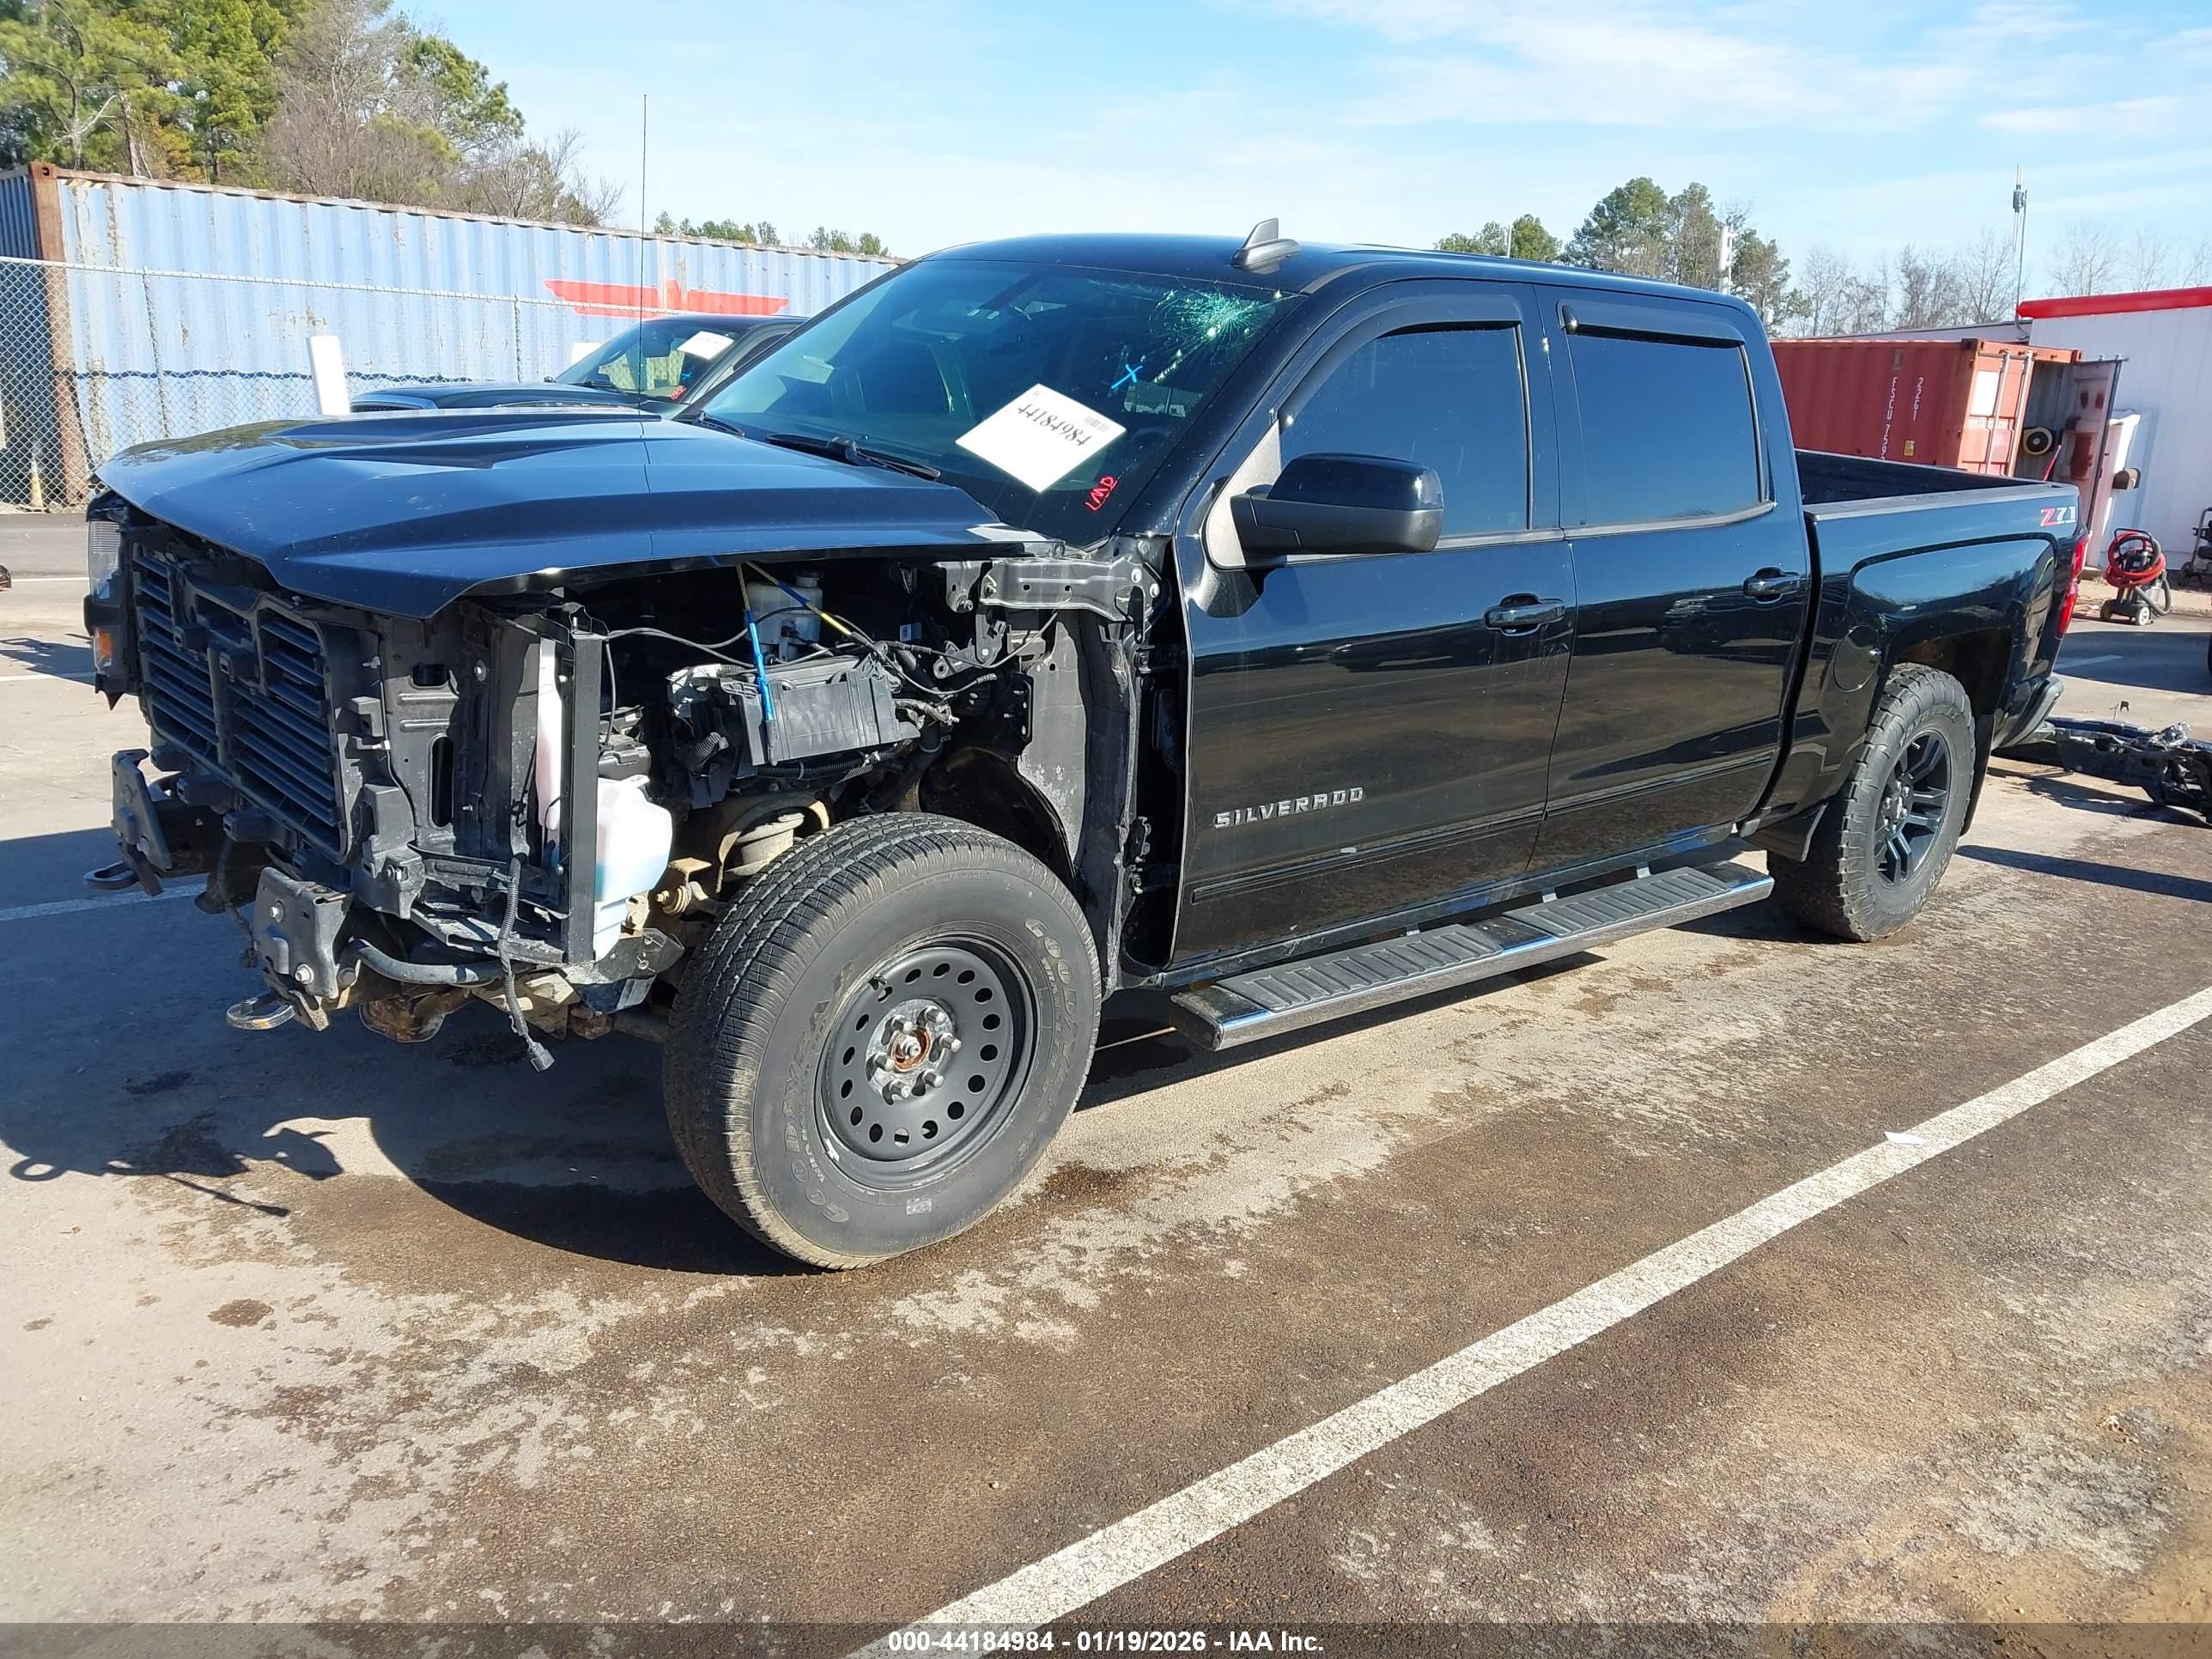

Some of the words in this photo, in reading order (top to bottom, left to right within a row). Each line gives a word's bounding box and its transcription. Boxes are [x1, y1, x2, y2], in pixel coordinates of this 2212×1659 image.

[1887, 376, 1899, 420] FSCU
[1912, 376, 1924, 422] 22G1
[1018, 404, 1093, 447] 44184984
[2040, 506, 2076, 527] Z71
[1213, 787, 1364, 830] SILVERADO
